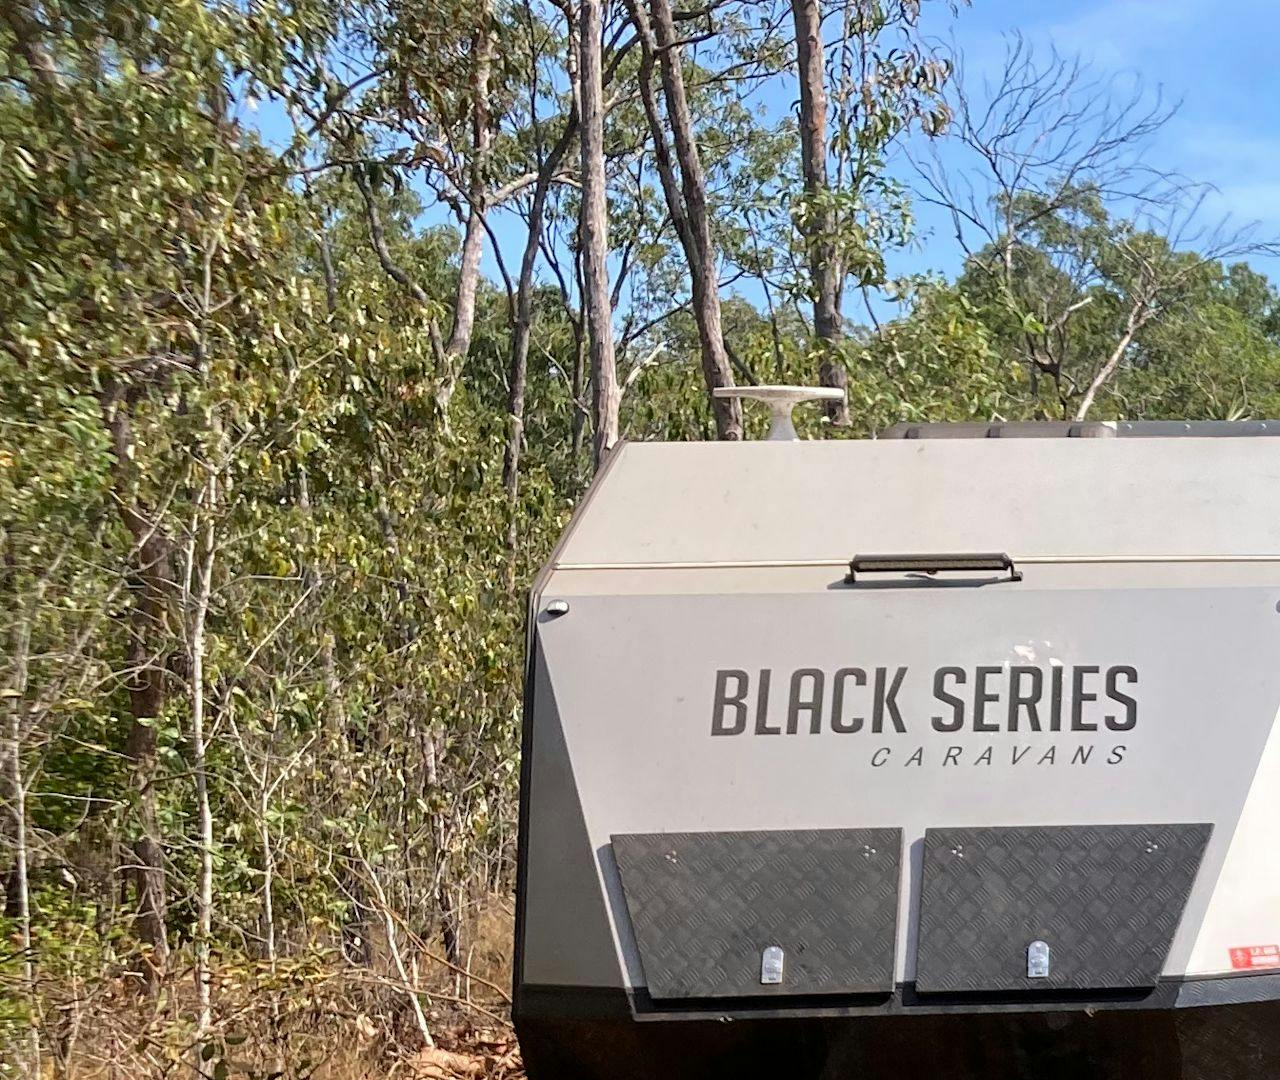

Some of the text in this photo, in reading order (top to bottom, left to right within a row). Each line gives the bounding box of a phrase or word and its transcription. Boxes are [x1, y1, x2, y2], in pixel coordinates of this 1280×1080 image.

[710, 665, 1139, 736] BLACK SERIES
[870, 745, 1127, 767] CARAVANS
